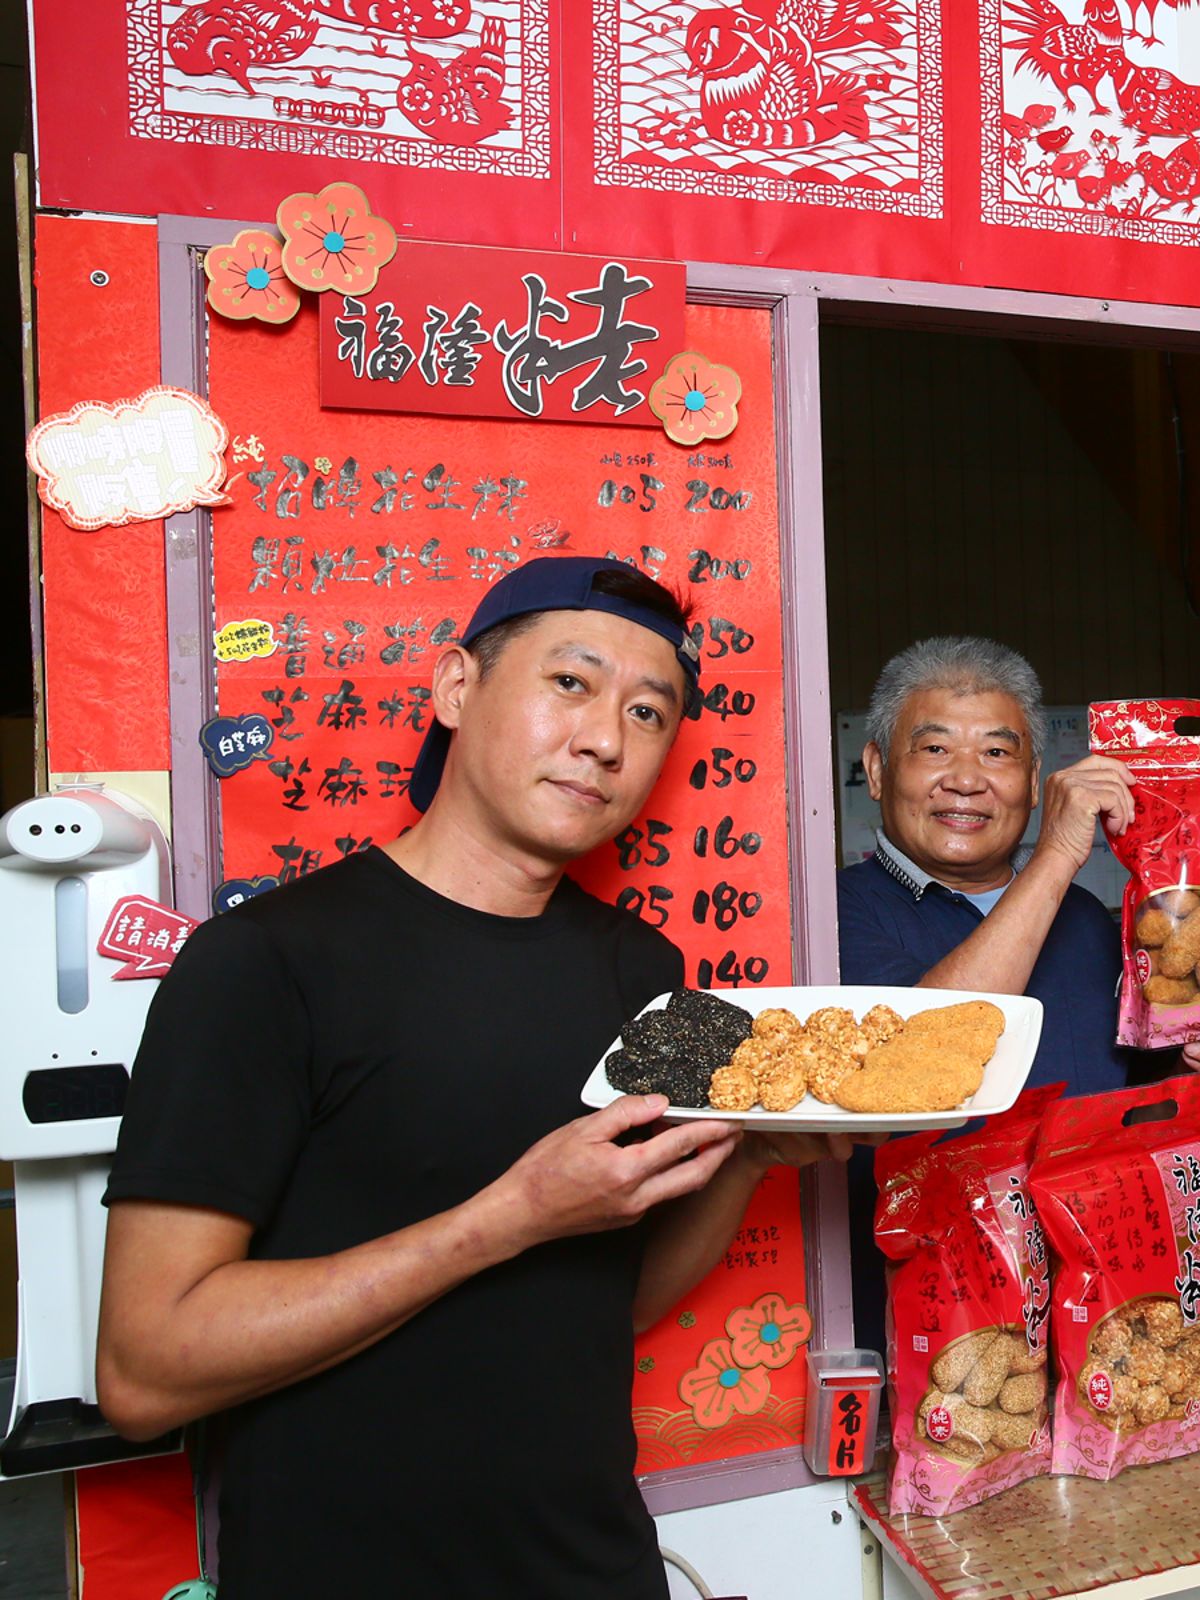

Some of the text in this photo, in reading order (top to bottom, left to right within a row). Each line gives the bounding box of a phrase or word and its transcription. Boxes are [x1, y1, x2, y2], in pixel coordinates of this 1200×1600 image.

[685, 479, 752, 513] 200
[687, 549, 752, 584] 200
[690, 616, 755, 658] 150
[218, 726, 267, 757] 白芝麻
[689, 747, 757, 790] 150
[615, 815, 762, 870] 85 160
[692, 881, 763, 932] 180
[115, 916, 189, 953] 請消毒
[697, 950, 769, 989] 140
[1091, 1378, 1109, 1405] 純素
[836, 1392, 863, 1469] 名片
[931, 1410, 949, 1438] 純素
